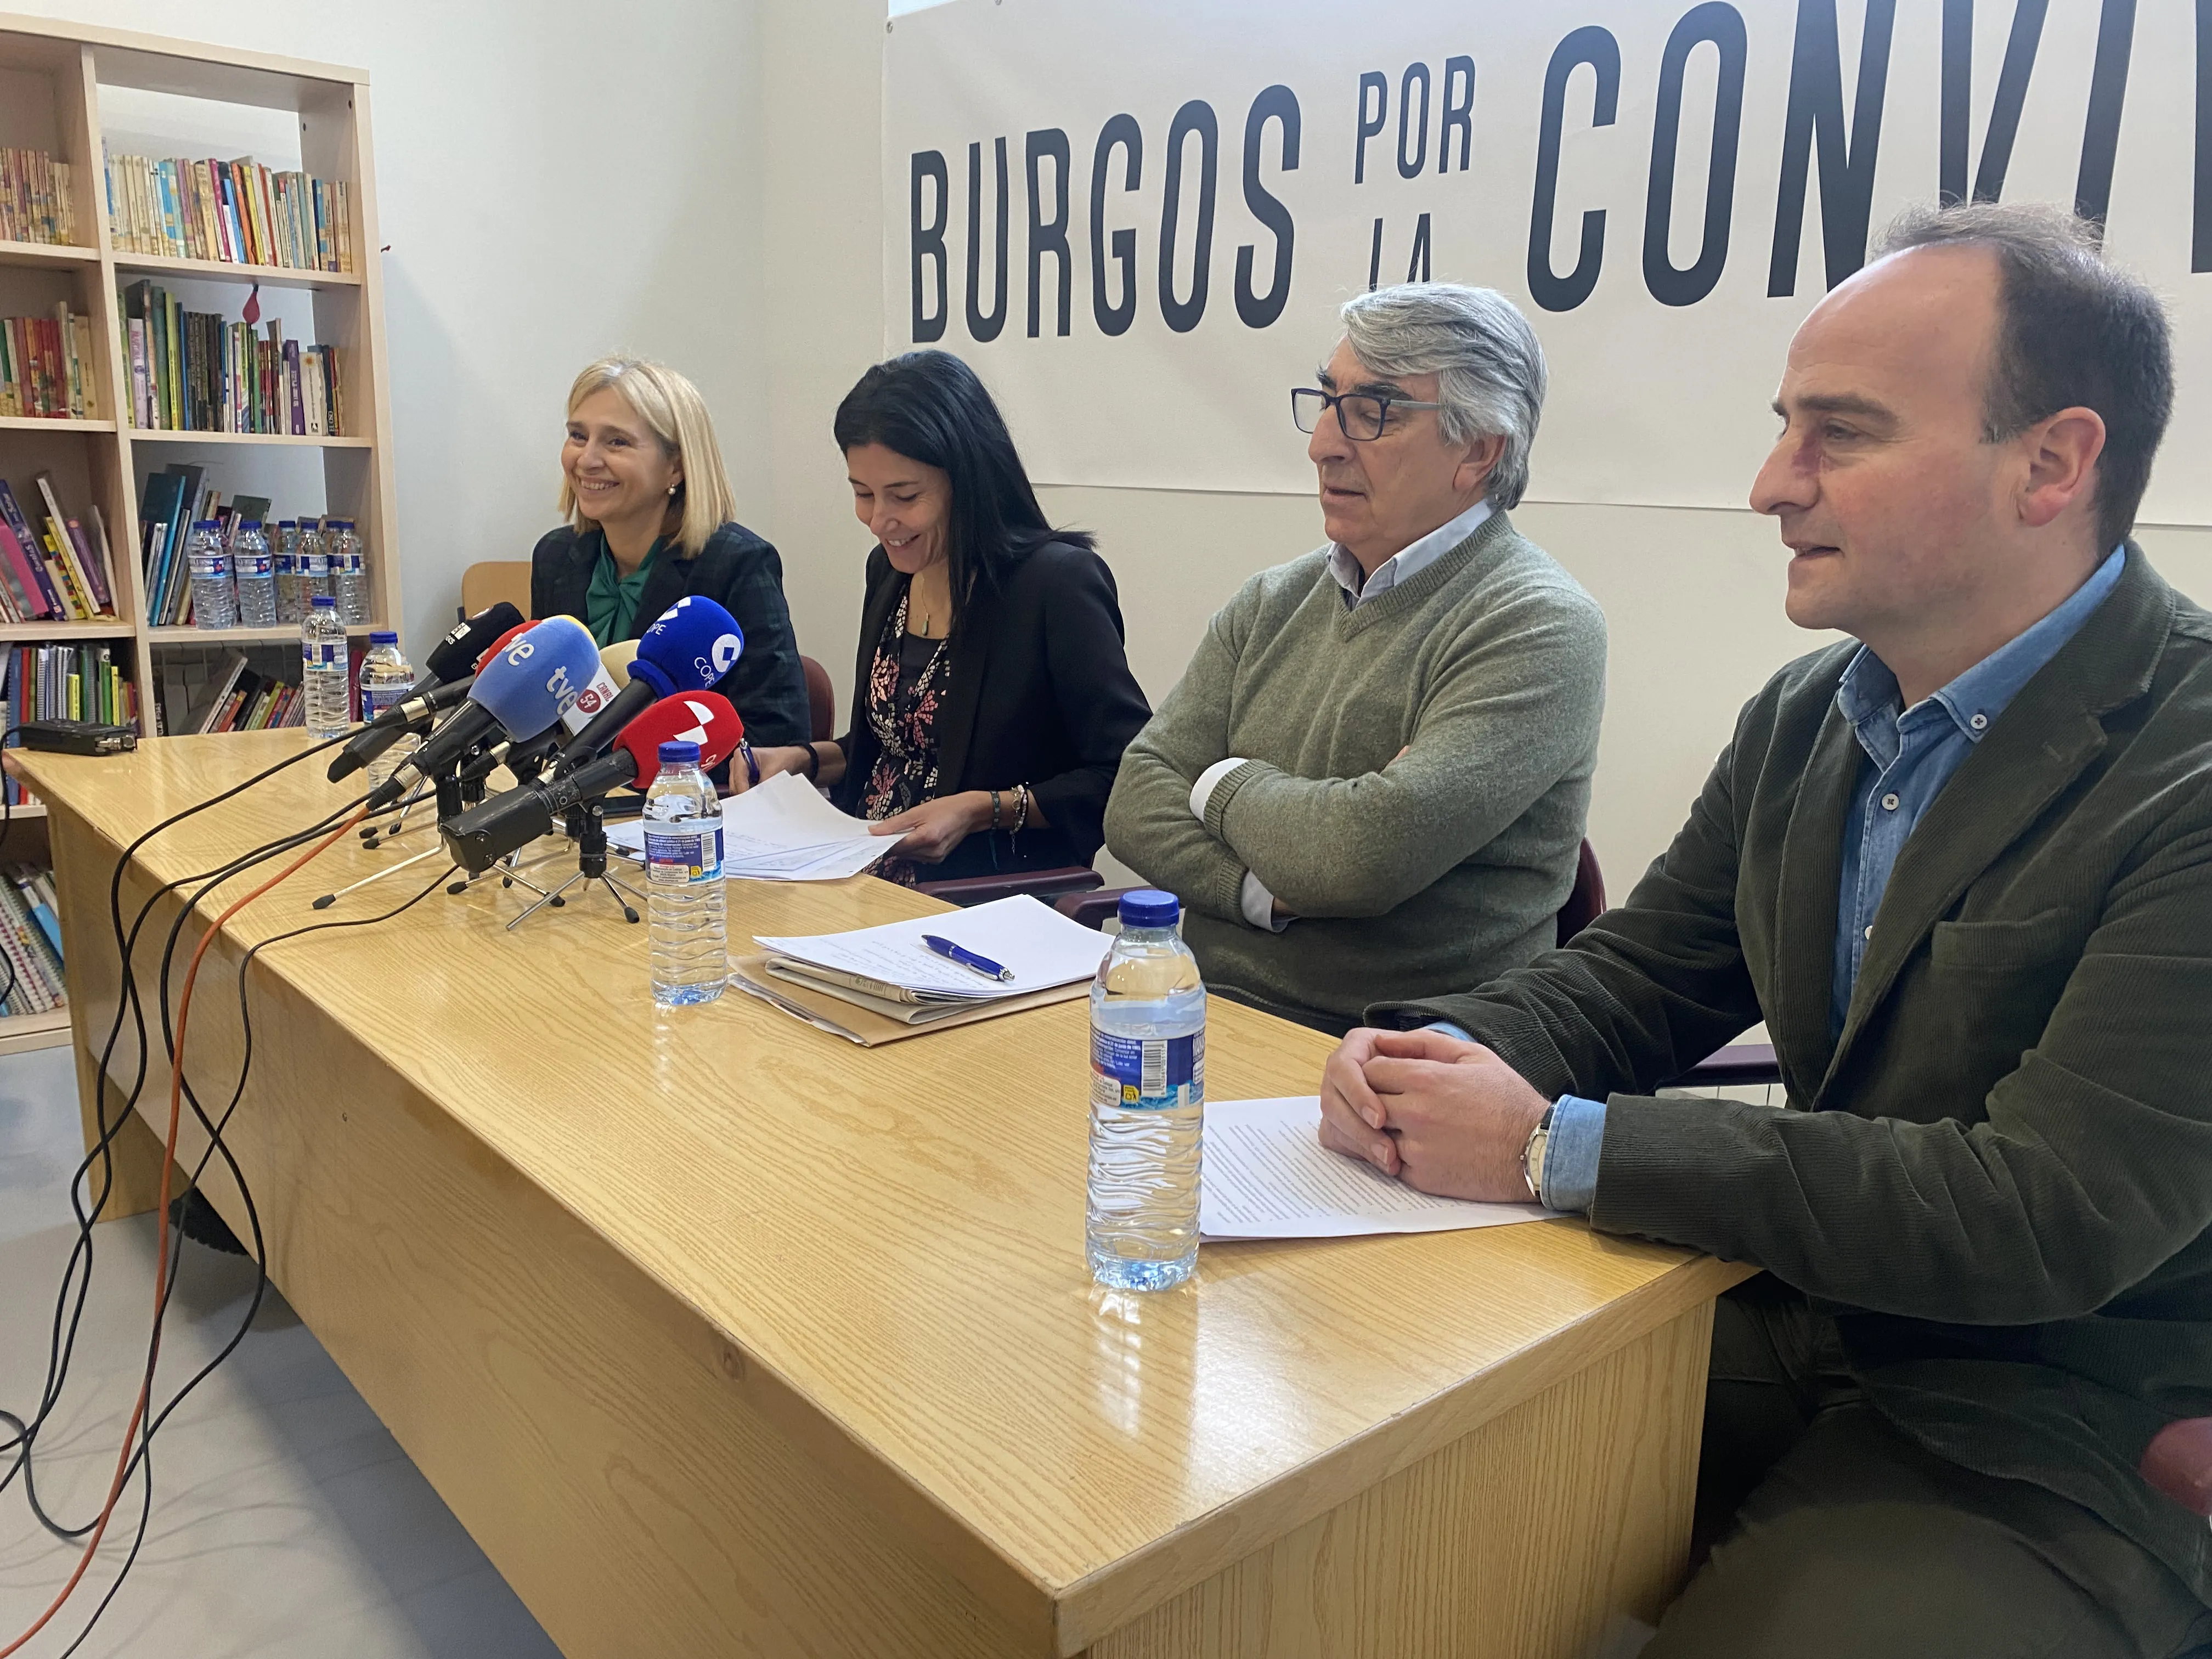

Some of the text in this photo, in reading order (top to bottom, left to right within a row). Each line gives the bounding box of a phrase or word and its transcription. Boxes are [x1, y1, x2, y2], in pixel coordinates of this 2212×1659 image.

[1355, 55, 1476, 184] POR
[1527, 0, 2212, 312] CONVI
[911, 84, 1302, 343] BURGOS
[646, 623, 667, 636] OPE
[546, 665, 578, 715] tve
[596, 682, 613, 702] CANAL
[694, 657, 715, 687] COPE
[579, 693, 597, 709] 54
